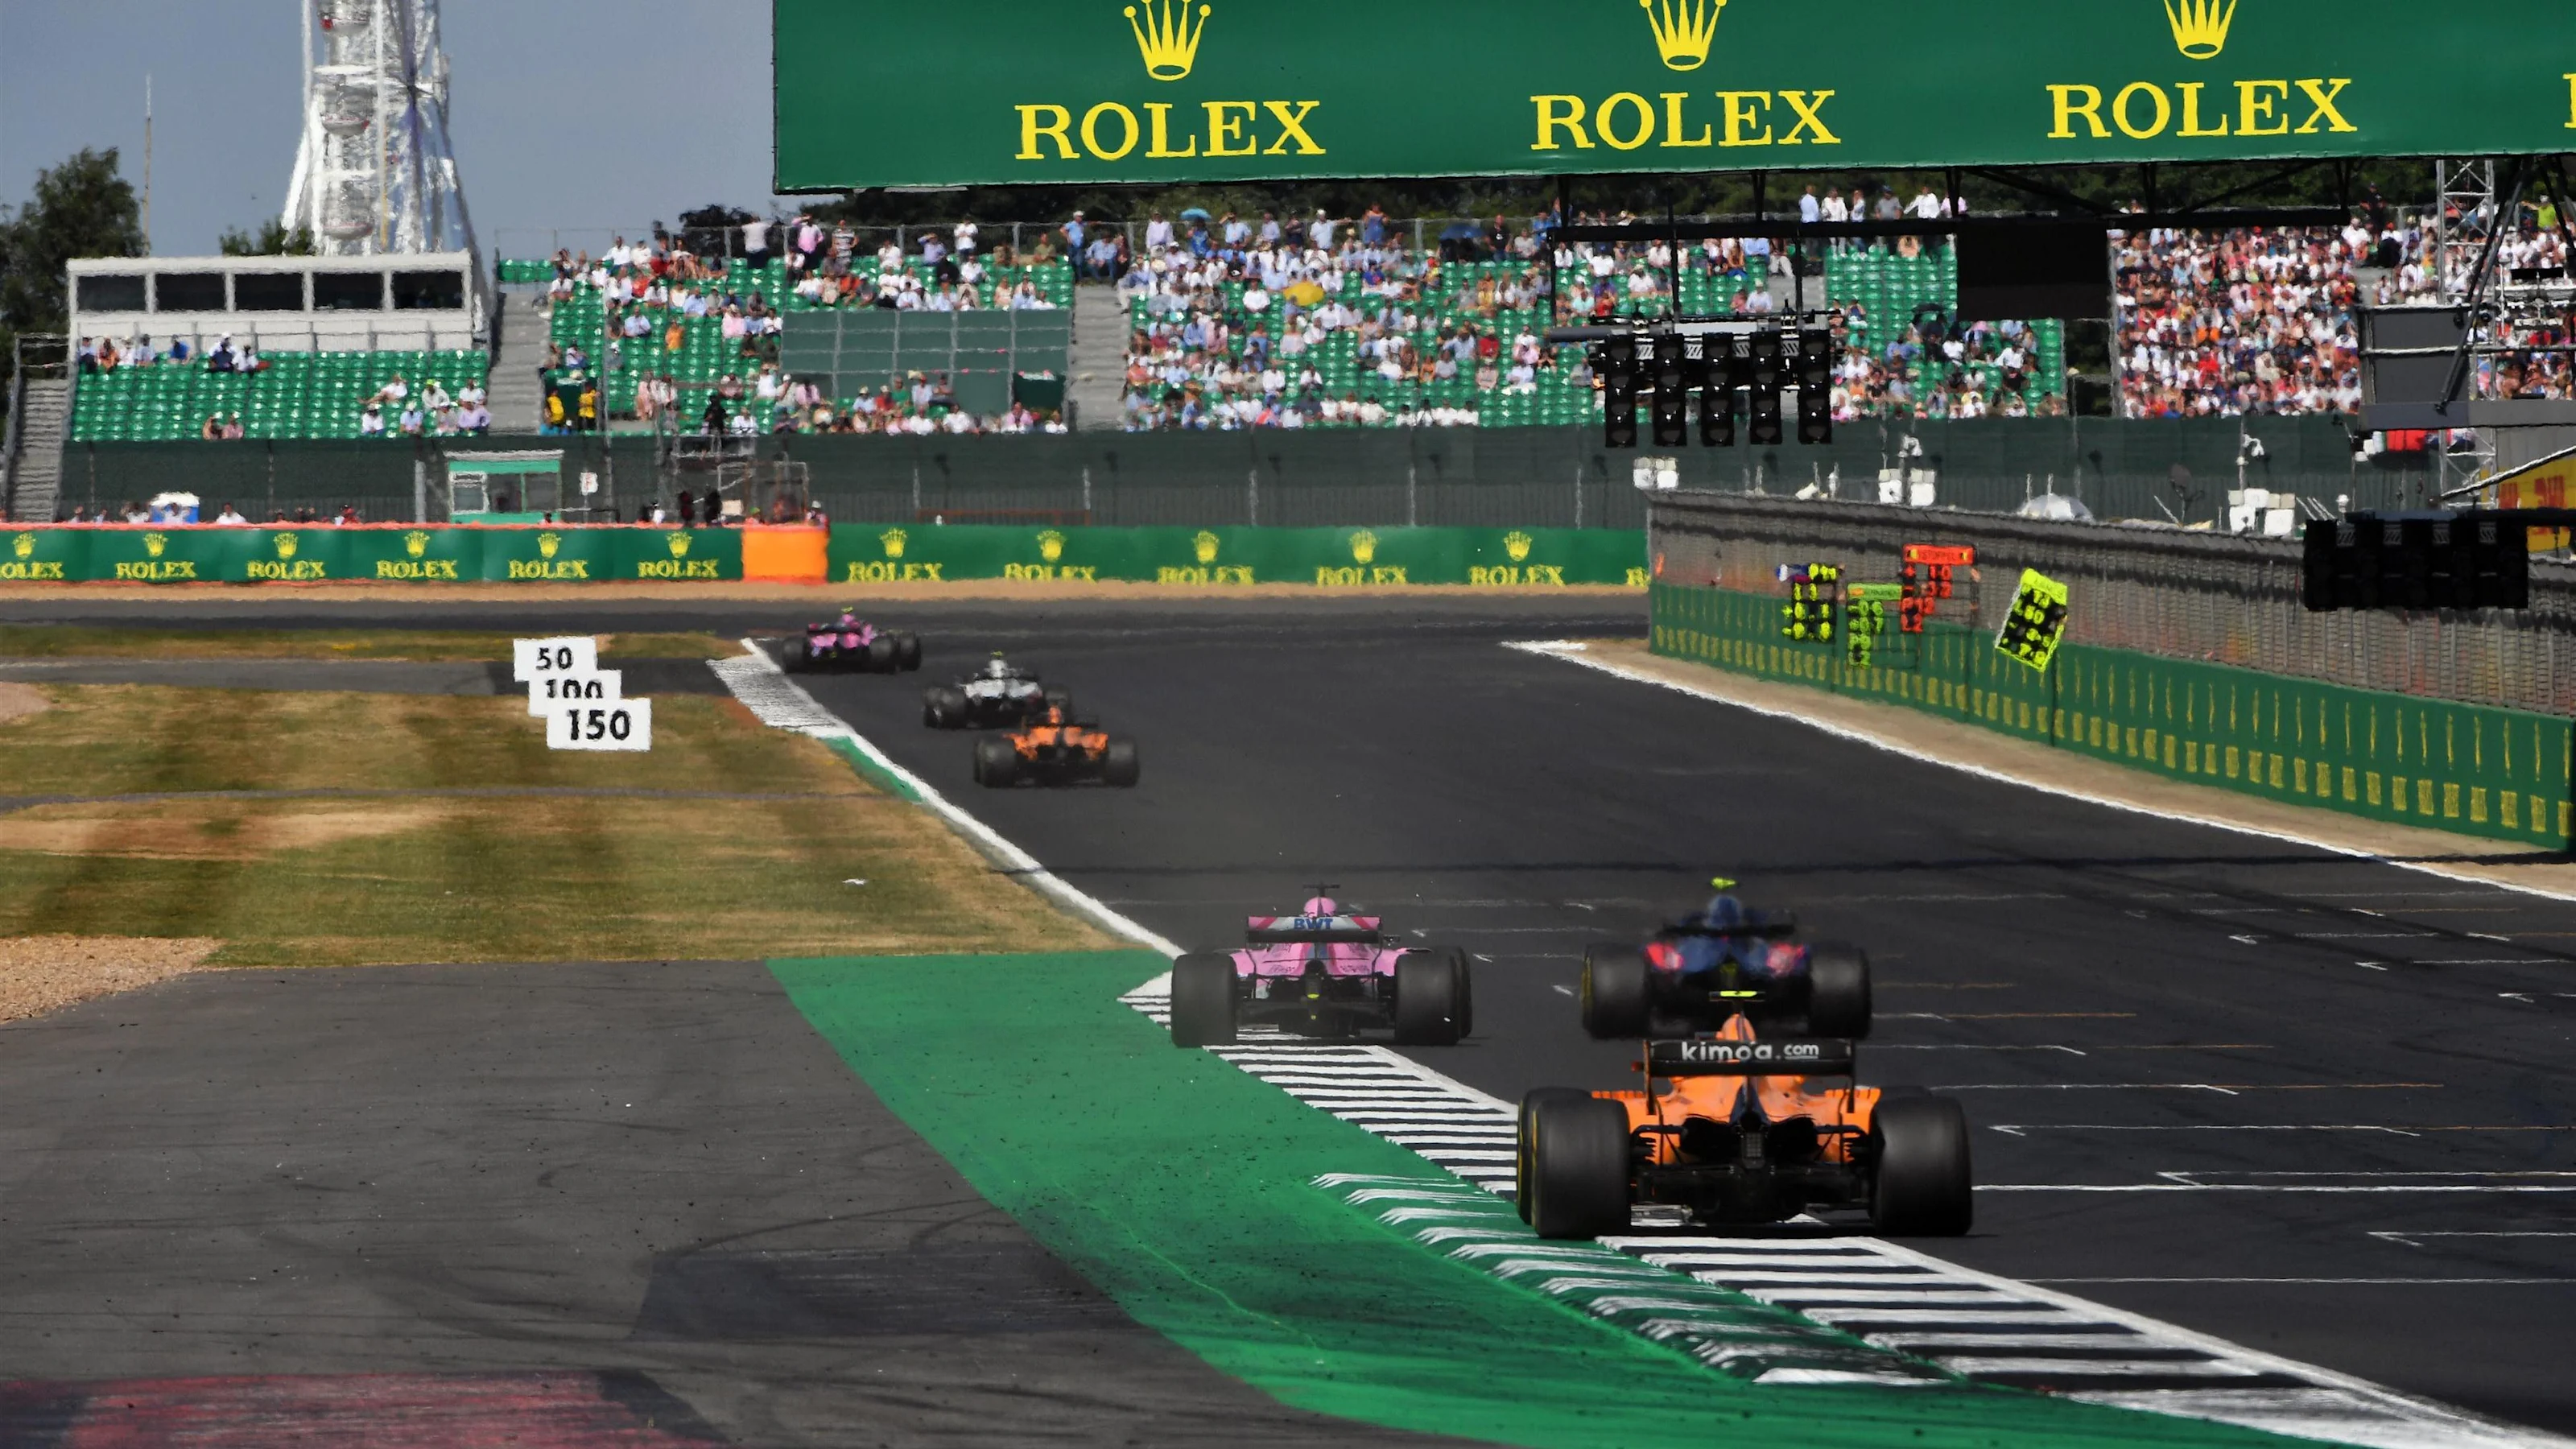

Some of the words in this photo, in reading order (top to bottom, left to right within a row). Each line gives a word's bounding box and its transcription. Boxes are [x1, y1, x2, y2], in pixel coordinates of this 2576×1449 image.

[2046, 78, 2356, 138] ROLEX
[1531, 90, 1839, 150] ROLEX
[1016, 101, 1325, 160] ROLEX
[0, 561, 64, 579] OLEX
[116, 561, 197, 580] ROLEX
[246, 559, 325, 579] ROLEX
[376, 559, 458, 579] ROLEX
[509, 559, 588, 579] ROLEX
[638, 559, 719, 578] ROLEX
[848, 561, 943, 583] ROLEX
[536, 646, 573, 670] 50
[546, 678, 604, 699] 100
[567, 709, 631, 741] 150
[1294, 918, 1333, 930] BWT
